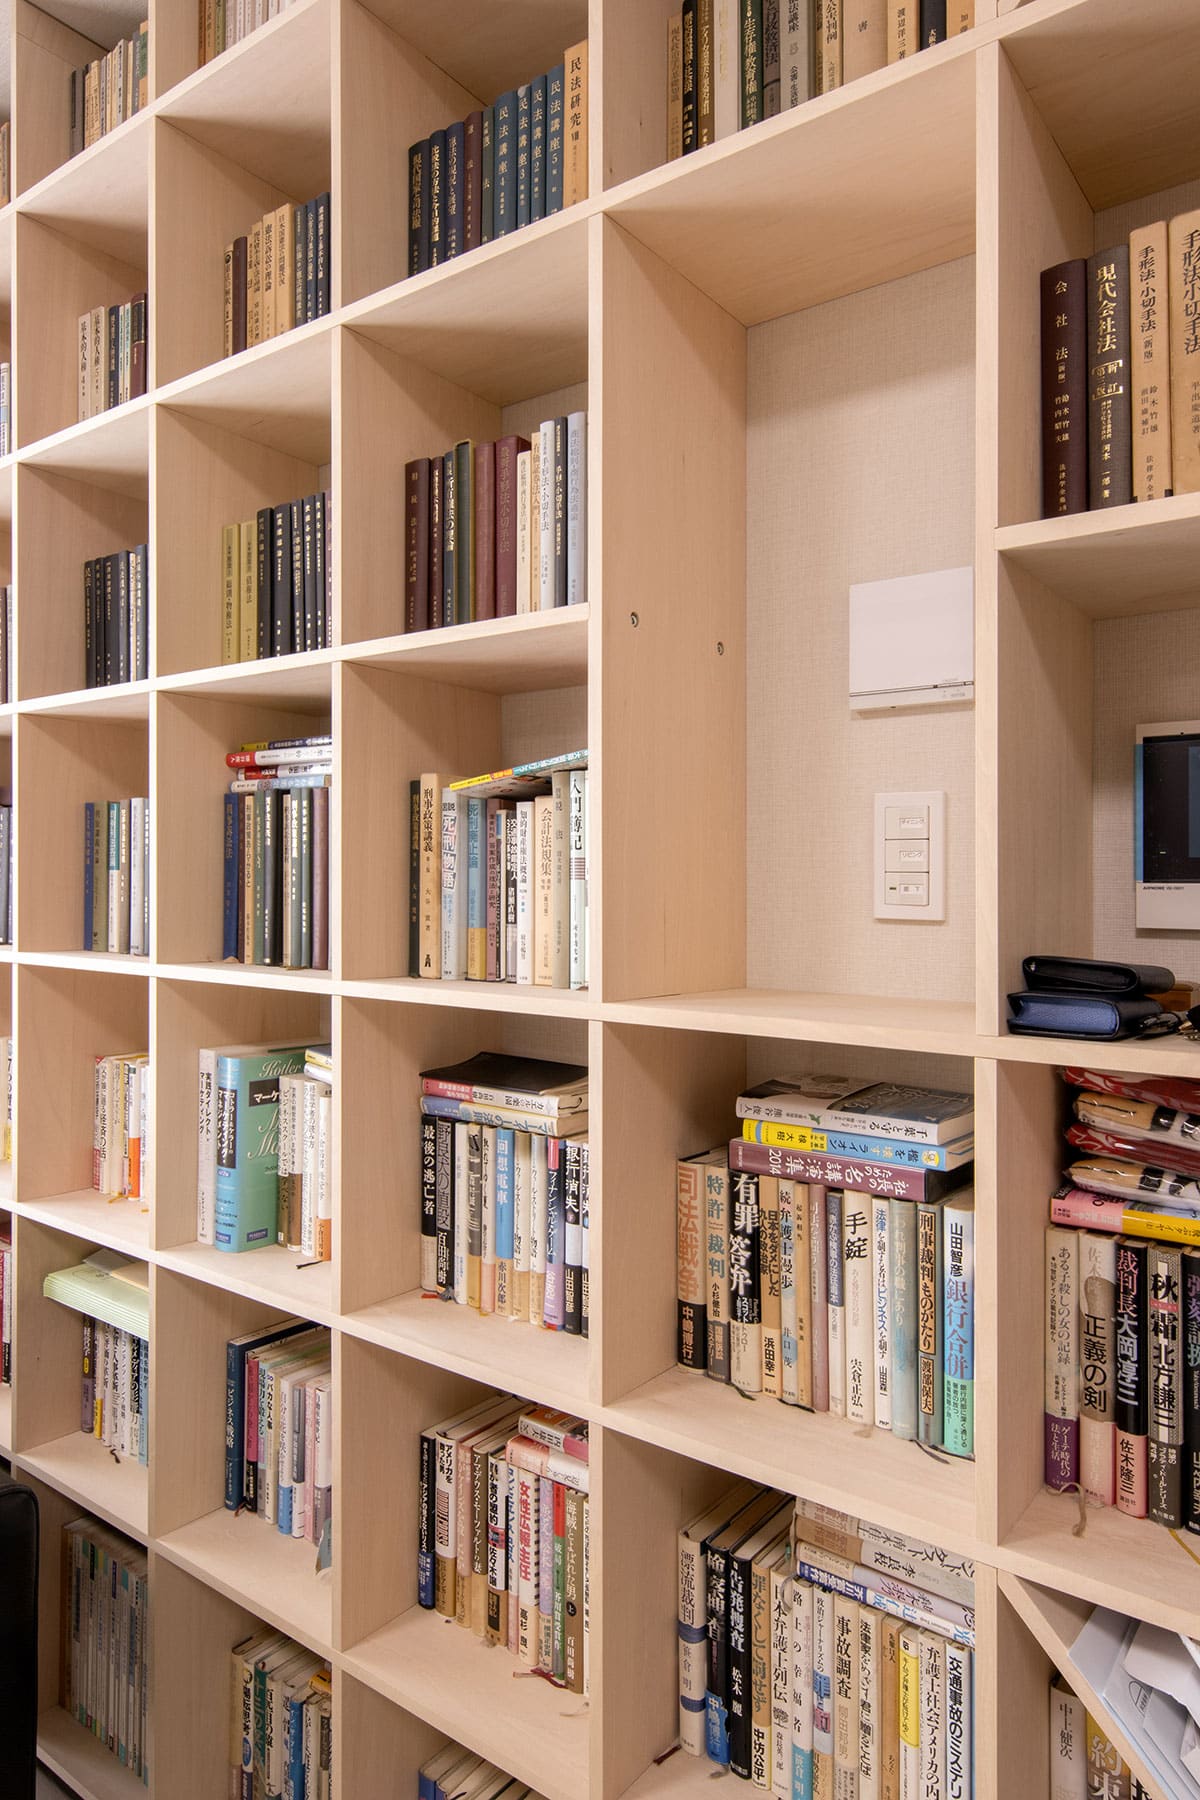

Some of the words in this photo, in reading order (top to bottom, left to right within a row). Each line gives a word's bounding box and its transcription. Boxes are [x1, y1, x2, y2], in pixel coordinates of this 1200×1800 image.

[1096, 263, 1117, 354] 現代会社法
[1139, 245, 1157, 334] 手形法・小切手法
[423, 788, 434, 853] 刑事政策講義
[442, 815, 457, 890] 死刑物語
[541, 807, 552, 877] 会計法規集
[901, 850, 922, 858] リビング
[259, 1058, 302, 1078] Kotler
[473, 1110, 547, 1133] マーフィーの法則
[505, 1095, 544, 1110] カエルの楽園
[744, 1104, 782, 1119] 熊谷俊人
[423, 1125, 436, 1216] 最後の逃亡者
[496, 1139, 508, 1206] 回想電車
[565, 1146, 580, 1213] 銀行消失
[768, 1148, 782, 1175] 2014
[785, 1155, 865, 1185] 名講演集
[829, 1137, 914, 1163] 檻を壊すライオン
[864, 1165, 893, 1178] ための
[869, 1177, 909, 1196] 社長の
[679, 1166, 699, 1300] 司法戦争
[707, 1174, 726, 1280] 特許裁判
[729, 1175, 760, 1296] 有罪答弁
[759, 1208, 769, 1275] 九人の政治家
[768, 1210, 780, 1297] 日本をダメにした
[780, 1190, 793, 1289] 続弁護士漫歩
[845, 1211, 868, 1261] 手錠
[949, 1222, 964, 1278] 山田智彦
[498, 1261, 507, 1304] 赤川次郎
[711, 1282, 721, 1318] 小杉健治
[919, 1212, 936, 1353] 刑事裁判ものがたり
[1057, 1246, 1071, 1366] ある子殺しの女の記録
[1117, 1249, 1138, 1318] 裁判長
[1150, 1273, 1178, 1342] 秋霜
[763, 1336, 777, 1378] 浜田幸一
[946, 1278, 969, 1379] 銀行合併
[921, 1359, 934, 1412] 渡部保夫
[1083, 1314, 1107, 1413] 正義の剣
[1117, 1316, 1139, 1407] 大岡淳三
[1152, 1343, 1176, 1431] 北方謙三
[444, 1443, 453, 1484] アメリカを
[1051, 1423, 1061, 1462] 法と生活
[1059, 1425, 1071, 1478] ゲーテ時代の
[1119, 1438, 1136, 1496] 佐木隆三
[519, 1480, 531, 1582] 女性広報主任
[679, 1549, 695, 1625] 漂流裁判
[873, 1551, 916, 1578] 李良枝
[519, 1607, 529, 1649] 高杉良
[872, 1593, 917, 1618] 辻仁成
[772, 1583, 788, 1704] 日本弁護士列伝
[836, 1615, 852, 1701] 事故調査
[752, 1728, 765, 1780] 中坊公平
[1059, 1702, 1073, 1761] 中上健次
[1090, 1735, 1123, 1800] 約束
